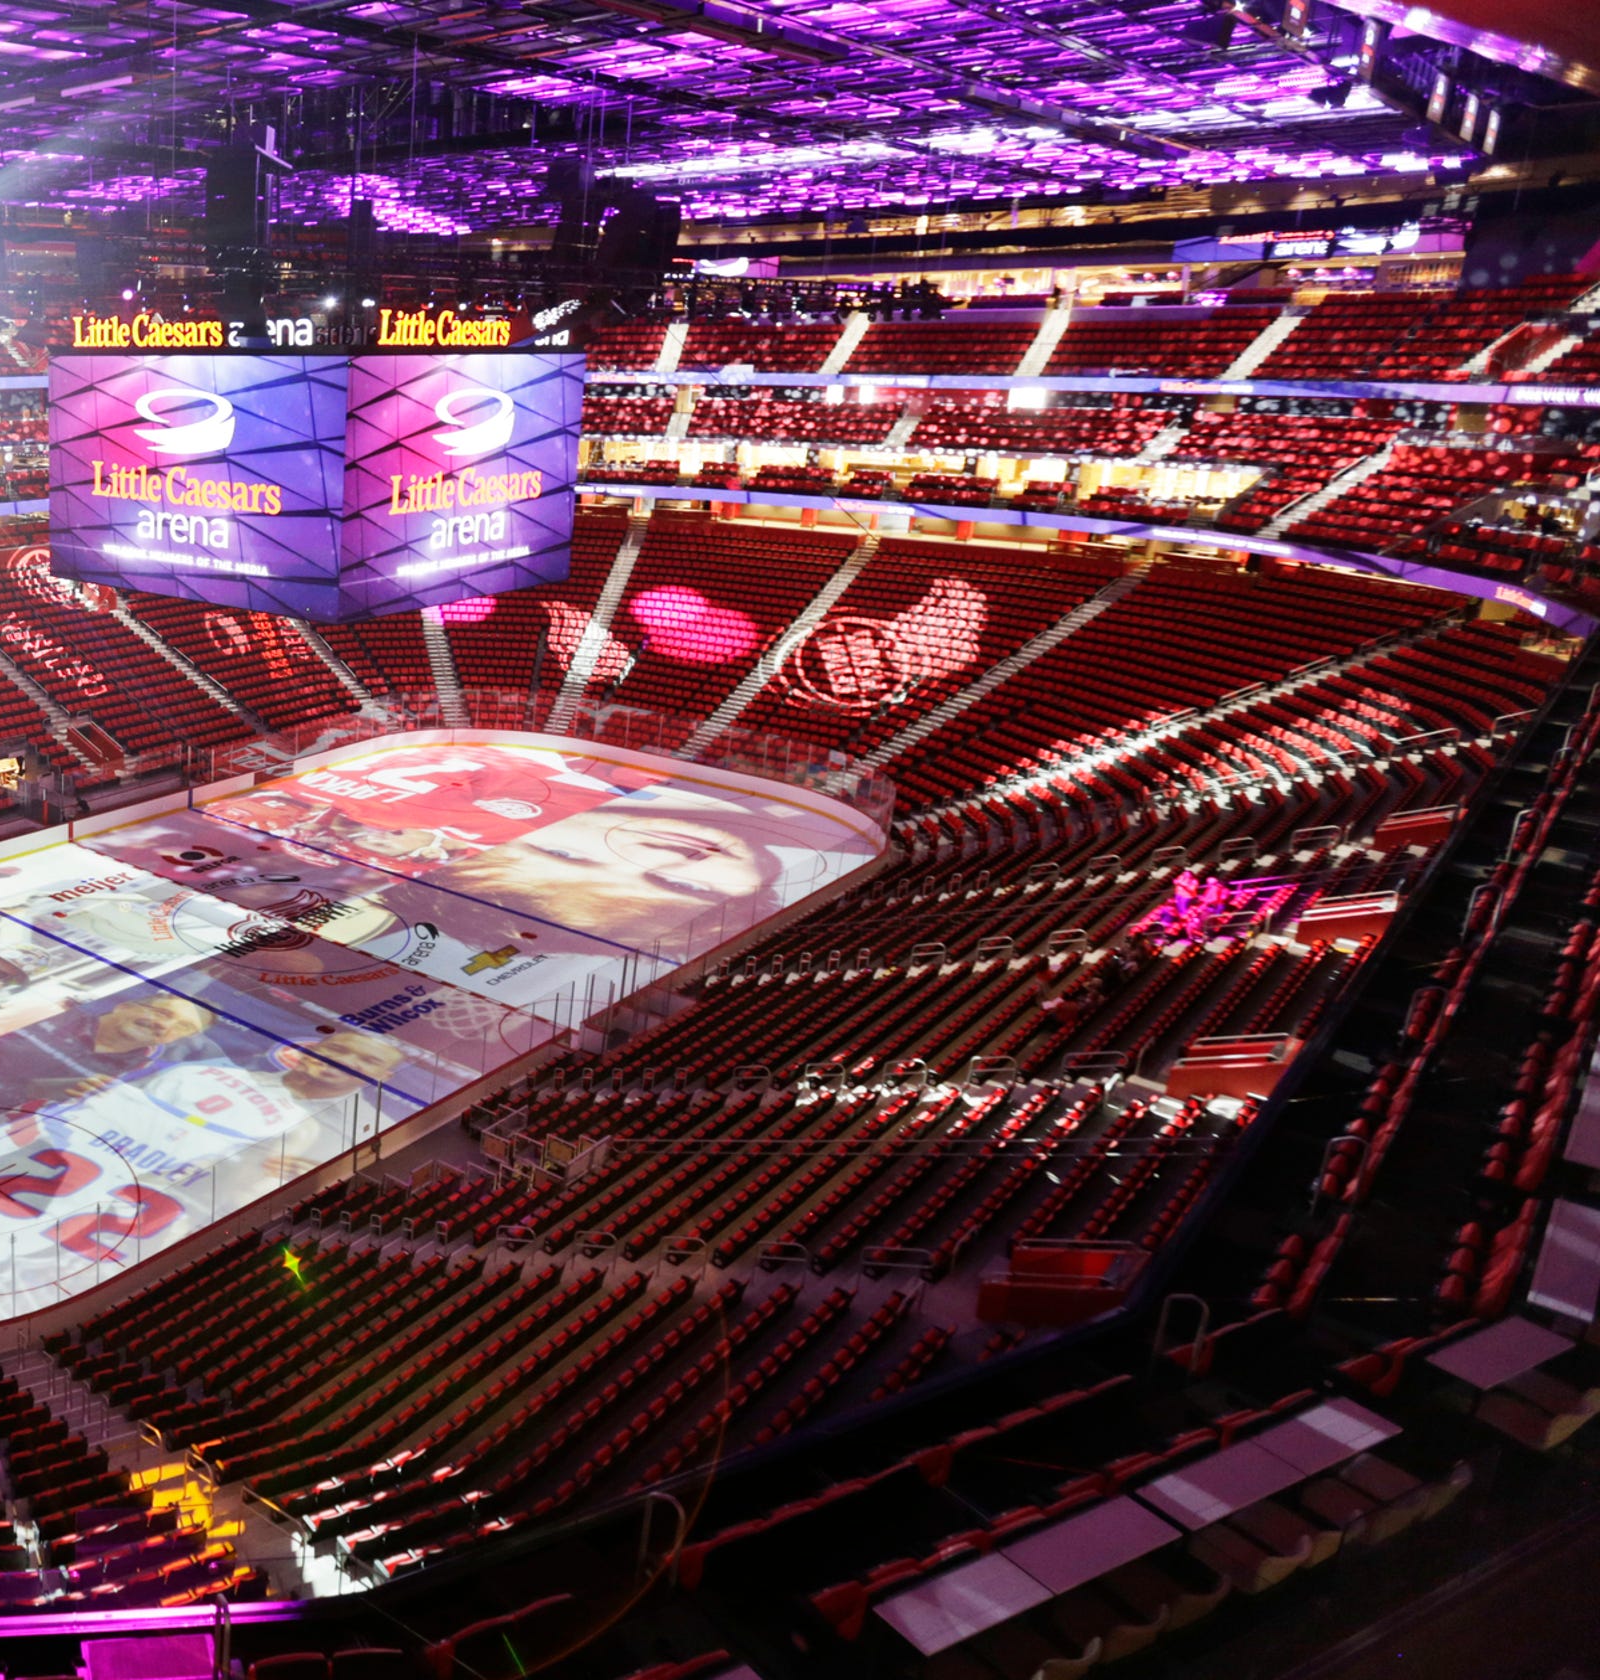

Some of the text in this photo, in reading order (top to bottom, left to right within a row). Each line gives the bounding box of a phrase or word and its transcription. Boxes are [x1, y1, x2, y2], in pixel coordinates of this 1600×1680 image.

[72, 314, 131, 347] Little
[132, 313, 223, 347] Caesars
[378, 308, 435, 346] Little
[436, 309, 511, 346] Caesars
[91, 460, 282, 516] Little Caesars
[388, 467, 542, 516] Little Caesars
[136, 509, 229, 549] arena
[430, 510, 505, 550] arena
[149, 550, 194, 566] MEMBERS
[195, 557, 211, 568] OF
[213, 559, 233, 572] THE
[234, 562, 269, 576] MEDIA
[48, 872, 134, 903] meijer
[402, 940, 437, 967] arena
[486, 953, 550, 987] CHEVROLET
[257, 966, 400, 987] Little Caesars
[338, 984, 427, 1027] Burns &
[360, 997, 446, 1035] Wilcox
[195, 1094, 233, 1115] 0
[88, 1129, 212, 1188] BRADLEY
